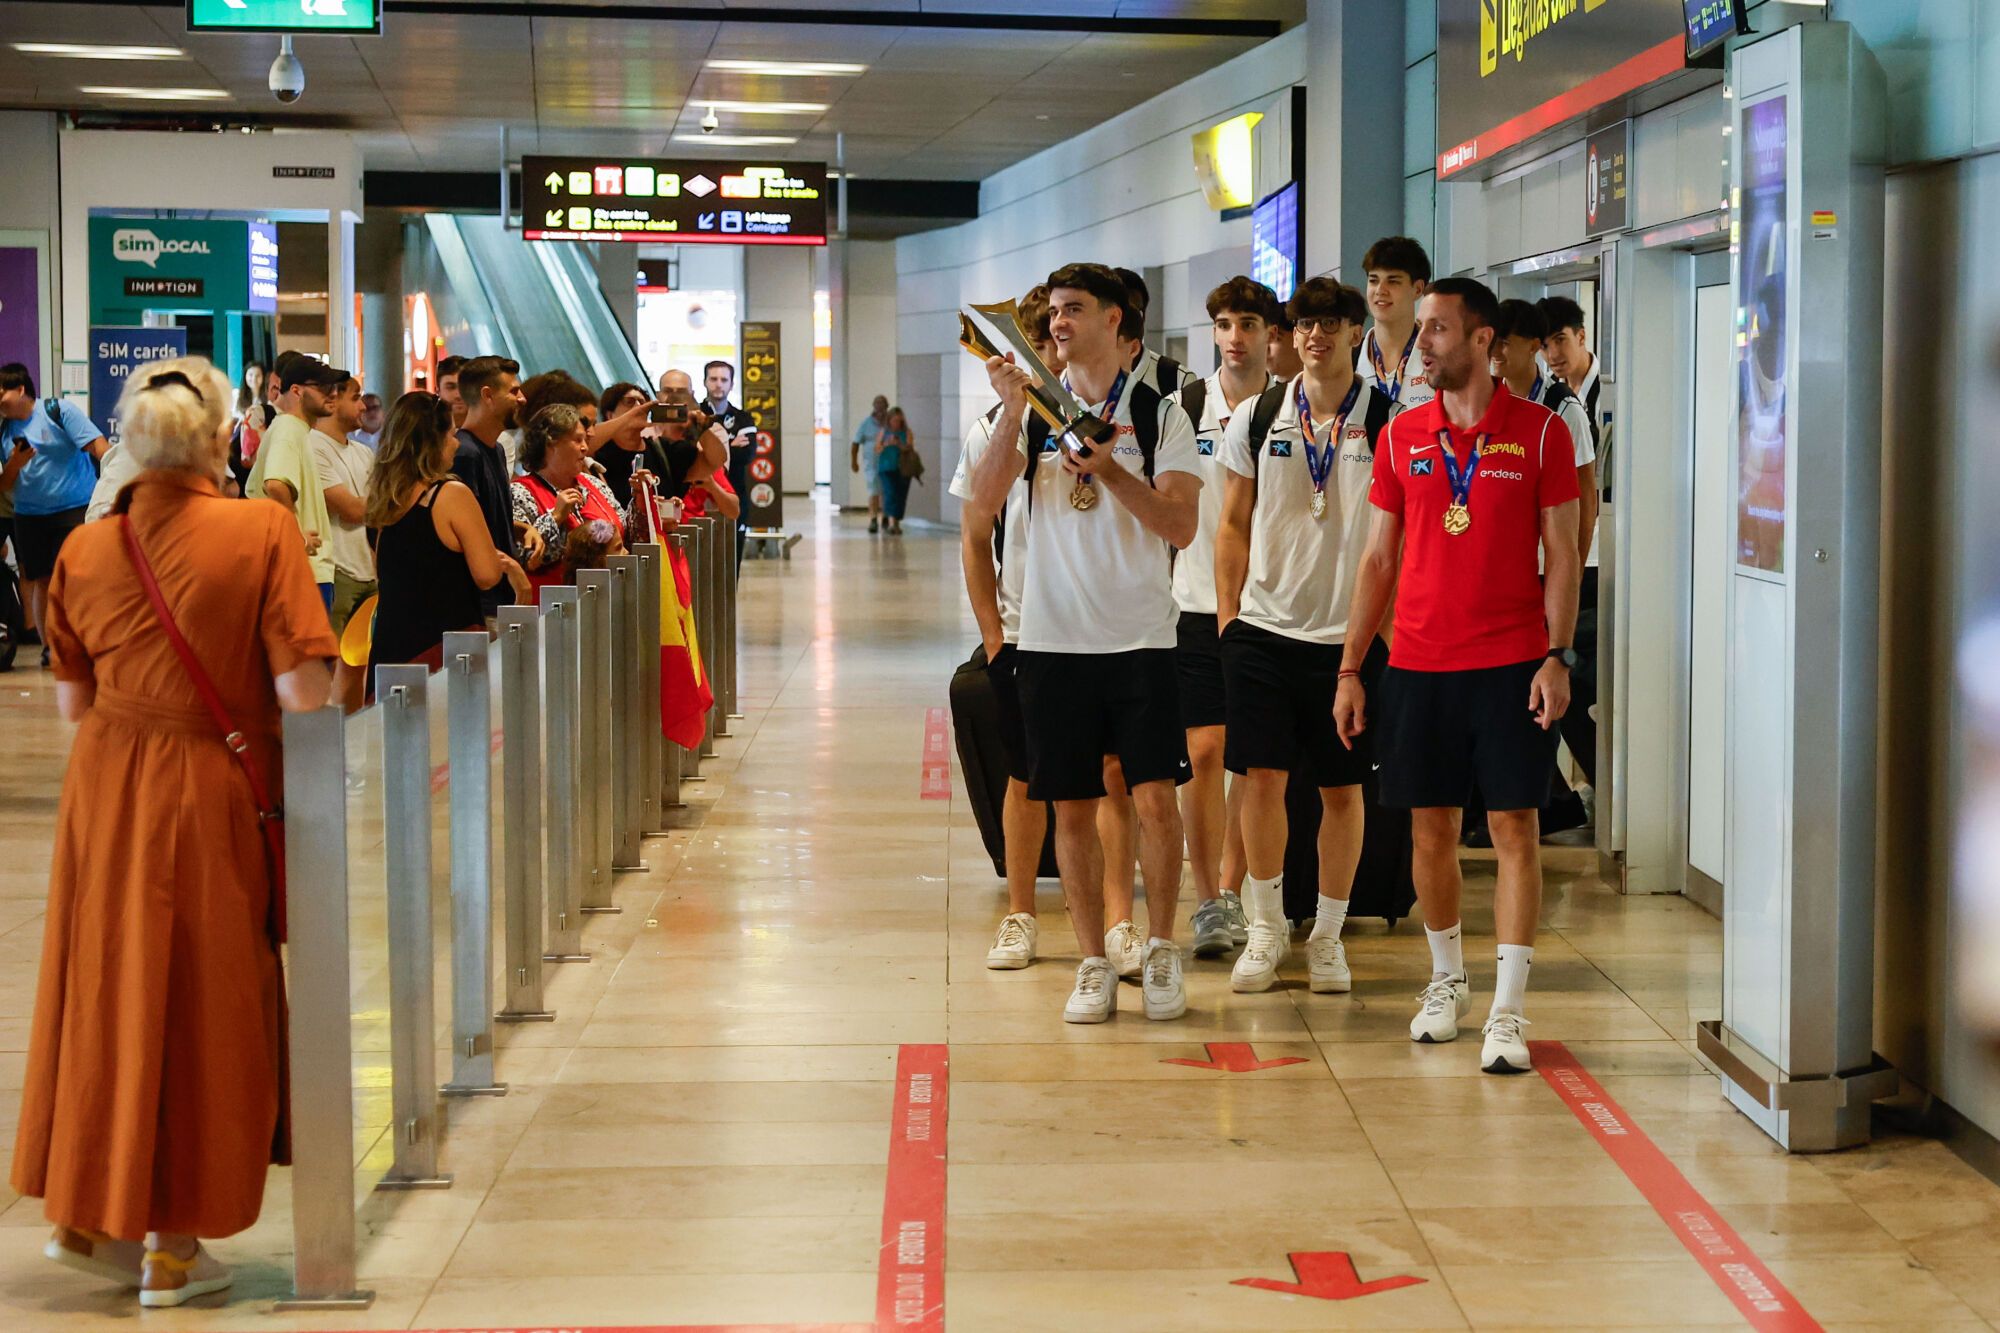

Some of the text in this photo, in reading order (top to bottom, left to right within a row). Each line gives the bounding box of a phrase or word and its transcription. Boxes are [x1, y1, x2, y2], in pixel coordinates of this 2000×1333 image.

[118, 235, 211, 254] sim LOCAL
[98, 343, 177, 359] SIM cards
[109, 364, 128, 376] on
[1112, 446, 1143, 457] endes
[1482, 443, 1525, 459] ESPAÑA
[1343, 453, 1374, 463] endes
[1480, 469, 1522, 480] endesa
